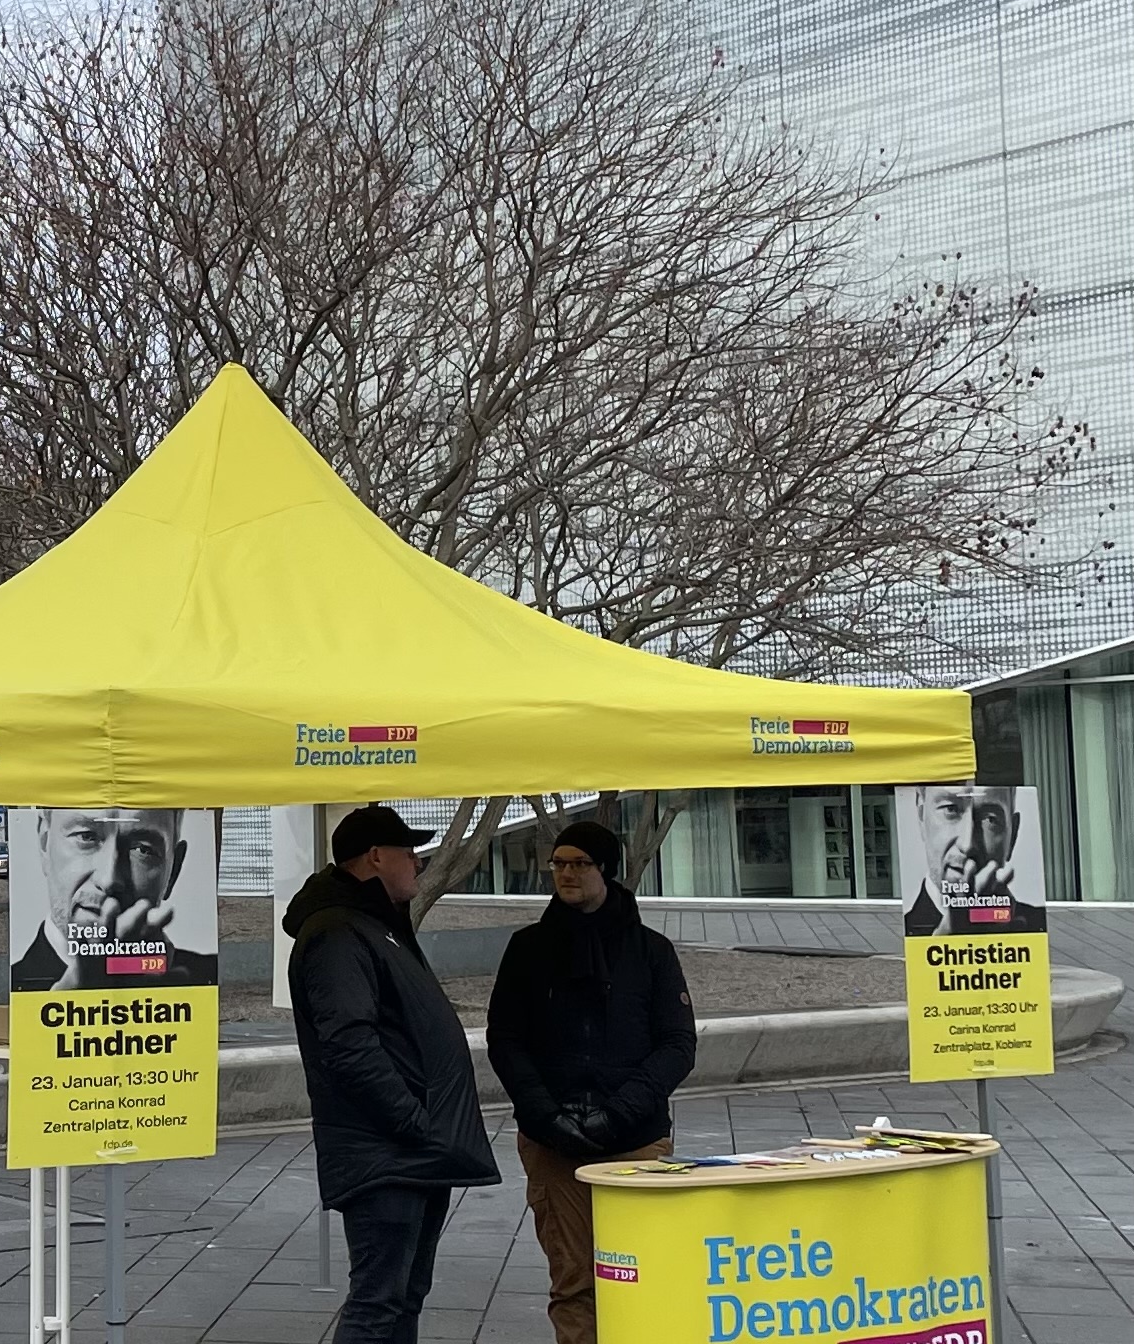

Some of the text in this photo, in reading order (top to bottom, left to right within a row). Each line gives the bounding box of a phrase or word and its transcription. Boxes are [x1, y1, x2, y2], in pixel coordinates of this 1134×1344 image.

[296, 723, 415, 743] Freie FDP
[751, 716, 846, 734] Freie FDP
[752, 736, 855, 754] Demokraten
[295, 745, 417, 766] Demokraten
[941, 880, 970, 894] Freie
[941, 893, 1011, 908] Demokraten
[67, 922, 108, 939] Freie
[67, 938, 166, 956] Demokraten
[926, 943, 1031, 966] Christian
[141, 958, 165, 971] FDP
[938, 969, 1022, 992] Lindner
[40, 998, 192, 1028] Christian
[923, 1001, 1039, 1018] 23. Januar, 13:30 Uhr
[949, 1022, 1017, 1036] Carina Konrad
[56, 1029, 178, 1059] Lindner
[933, 1039, 1033, 1054] Zentralplatz, Koblenz
[31, 1069, 199, 1091] 23. Januar, 13:30 Uhr
[68, 1094, 166, 1112] Carina Konrad
[43, 1115, 188, 1135] Zentralplatz, Koblenz
[103, 1139, 134, 1150] fdp.de
[704, 1229, 833, 1285] Freie
[614, 1268, 636, 1281] FDP
[707, 1274, 985, 1343] Demokraten
